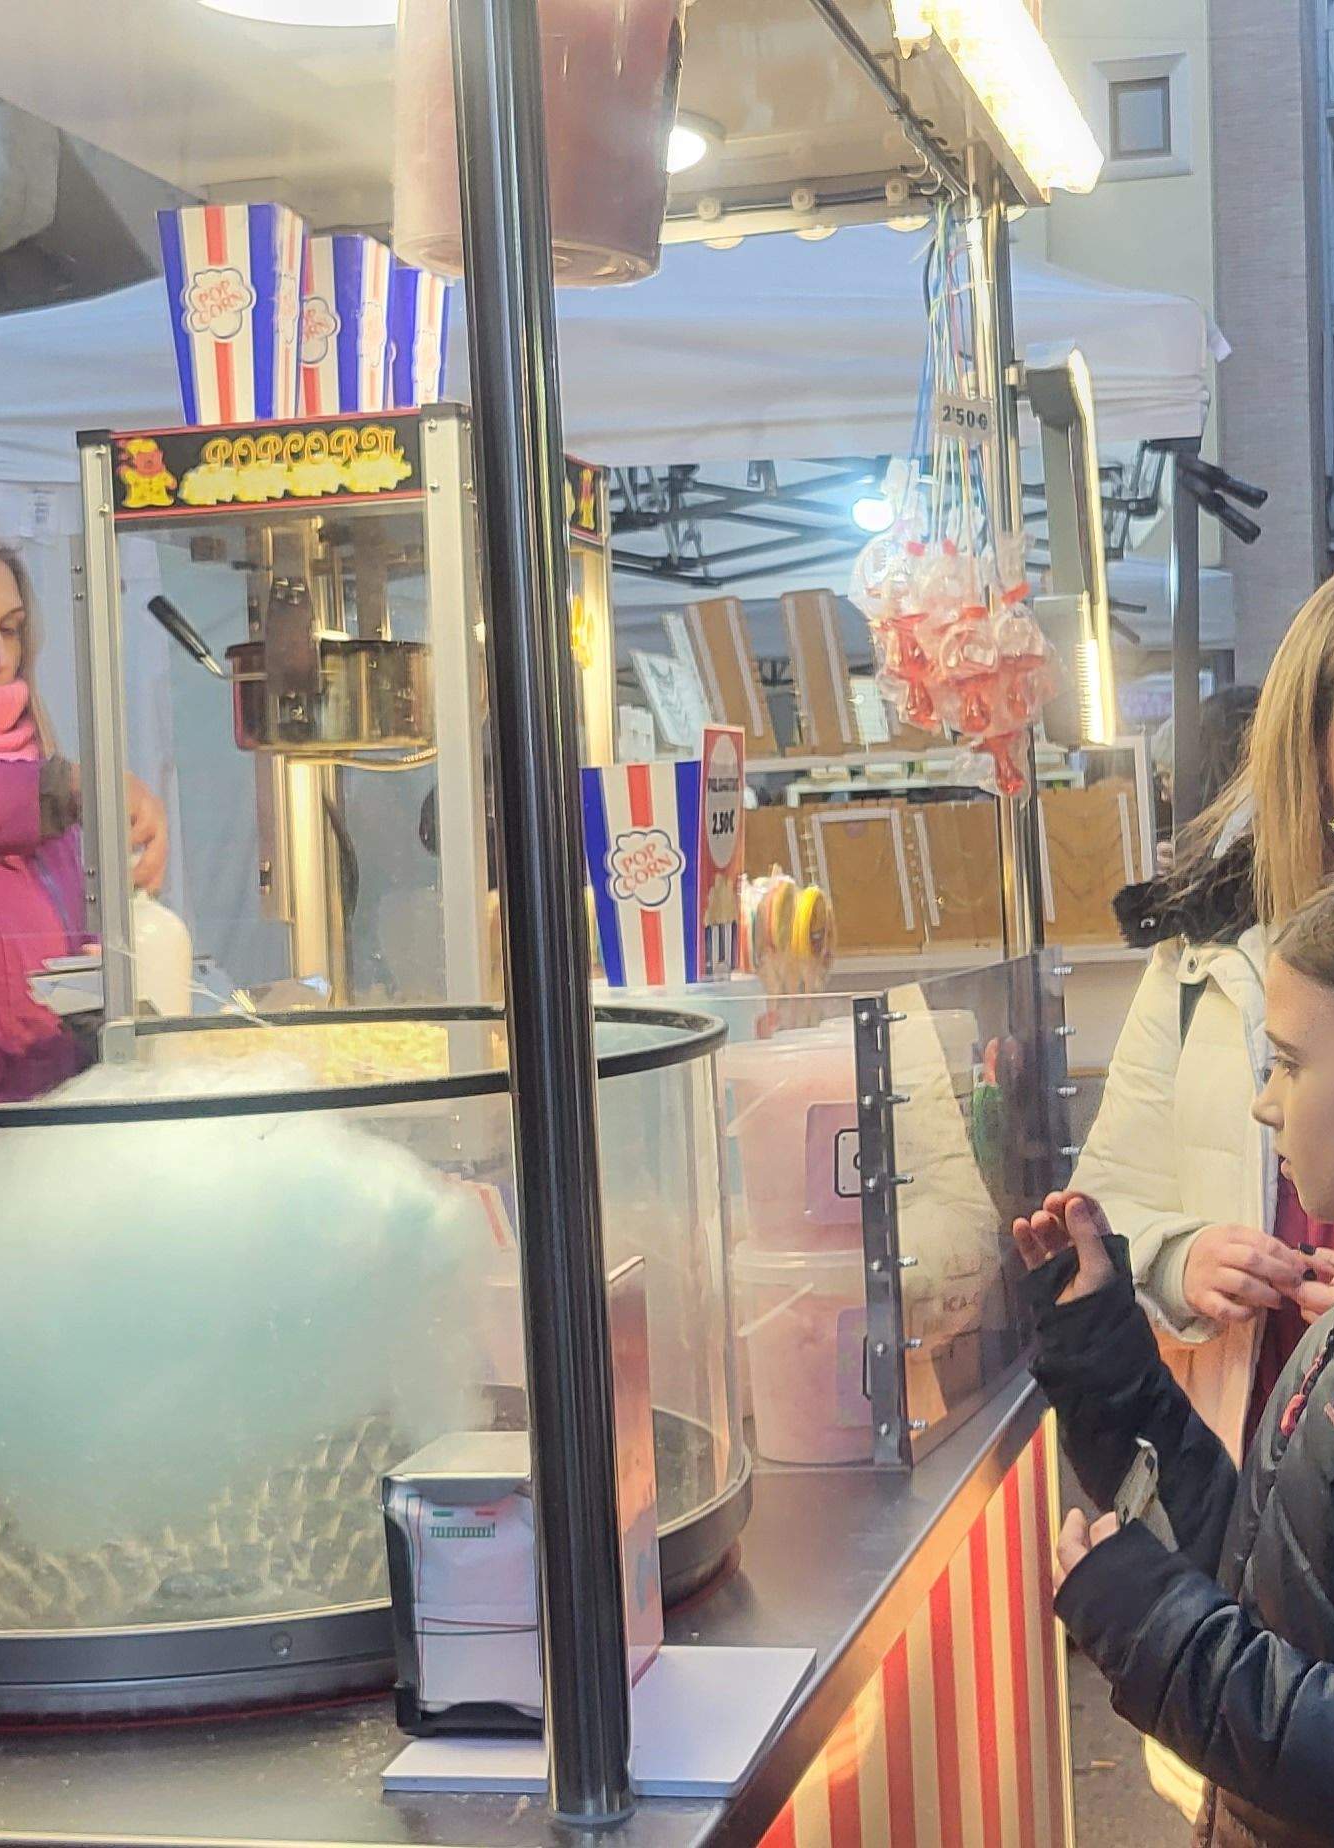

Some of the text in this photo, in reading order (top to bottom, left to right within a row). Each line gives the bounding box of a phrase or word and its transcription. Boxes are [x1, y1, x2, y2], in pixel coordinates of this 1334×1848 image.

[199, 279, 229, 304] POP
[199, 292, 243, 325] CORN
[203, 427, 403, 469] POPCORN
[622, 842, 657, 872] POP
[622, 855, 672, 892] CORN
